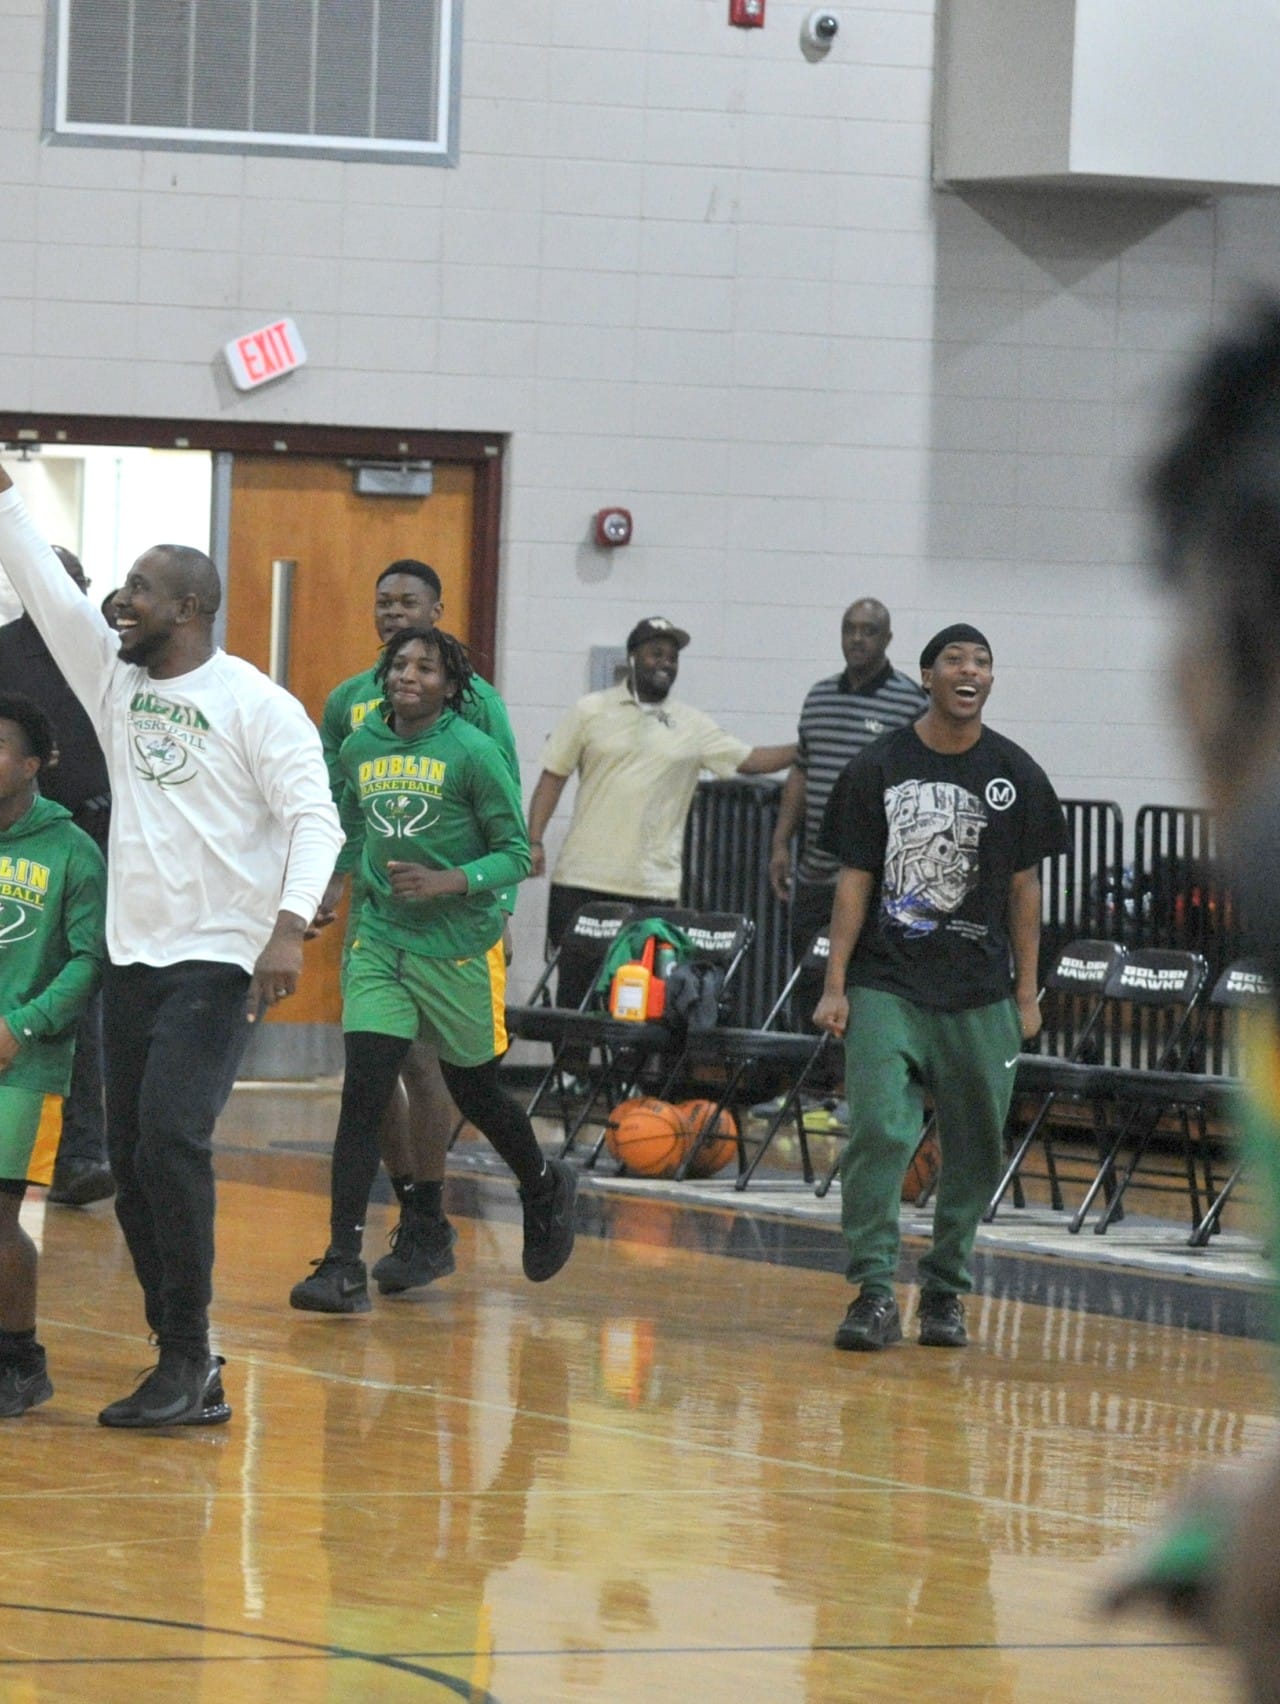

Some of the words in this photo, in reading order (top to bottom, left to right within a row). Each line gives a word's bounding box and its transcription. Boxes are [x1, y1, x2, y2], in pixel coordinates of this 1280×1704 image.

[236, 322, 297, 383] EXIT
[359, 755, 446, 786] DUBLIN
[991, 786, 1011, 803] M
[1061, 956, 1109, 971] GOLDEN
[1123, 965, 1189, 980] GOLDEN
